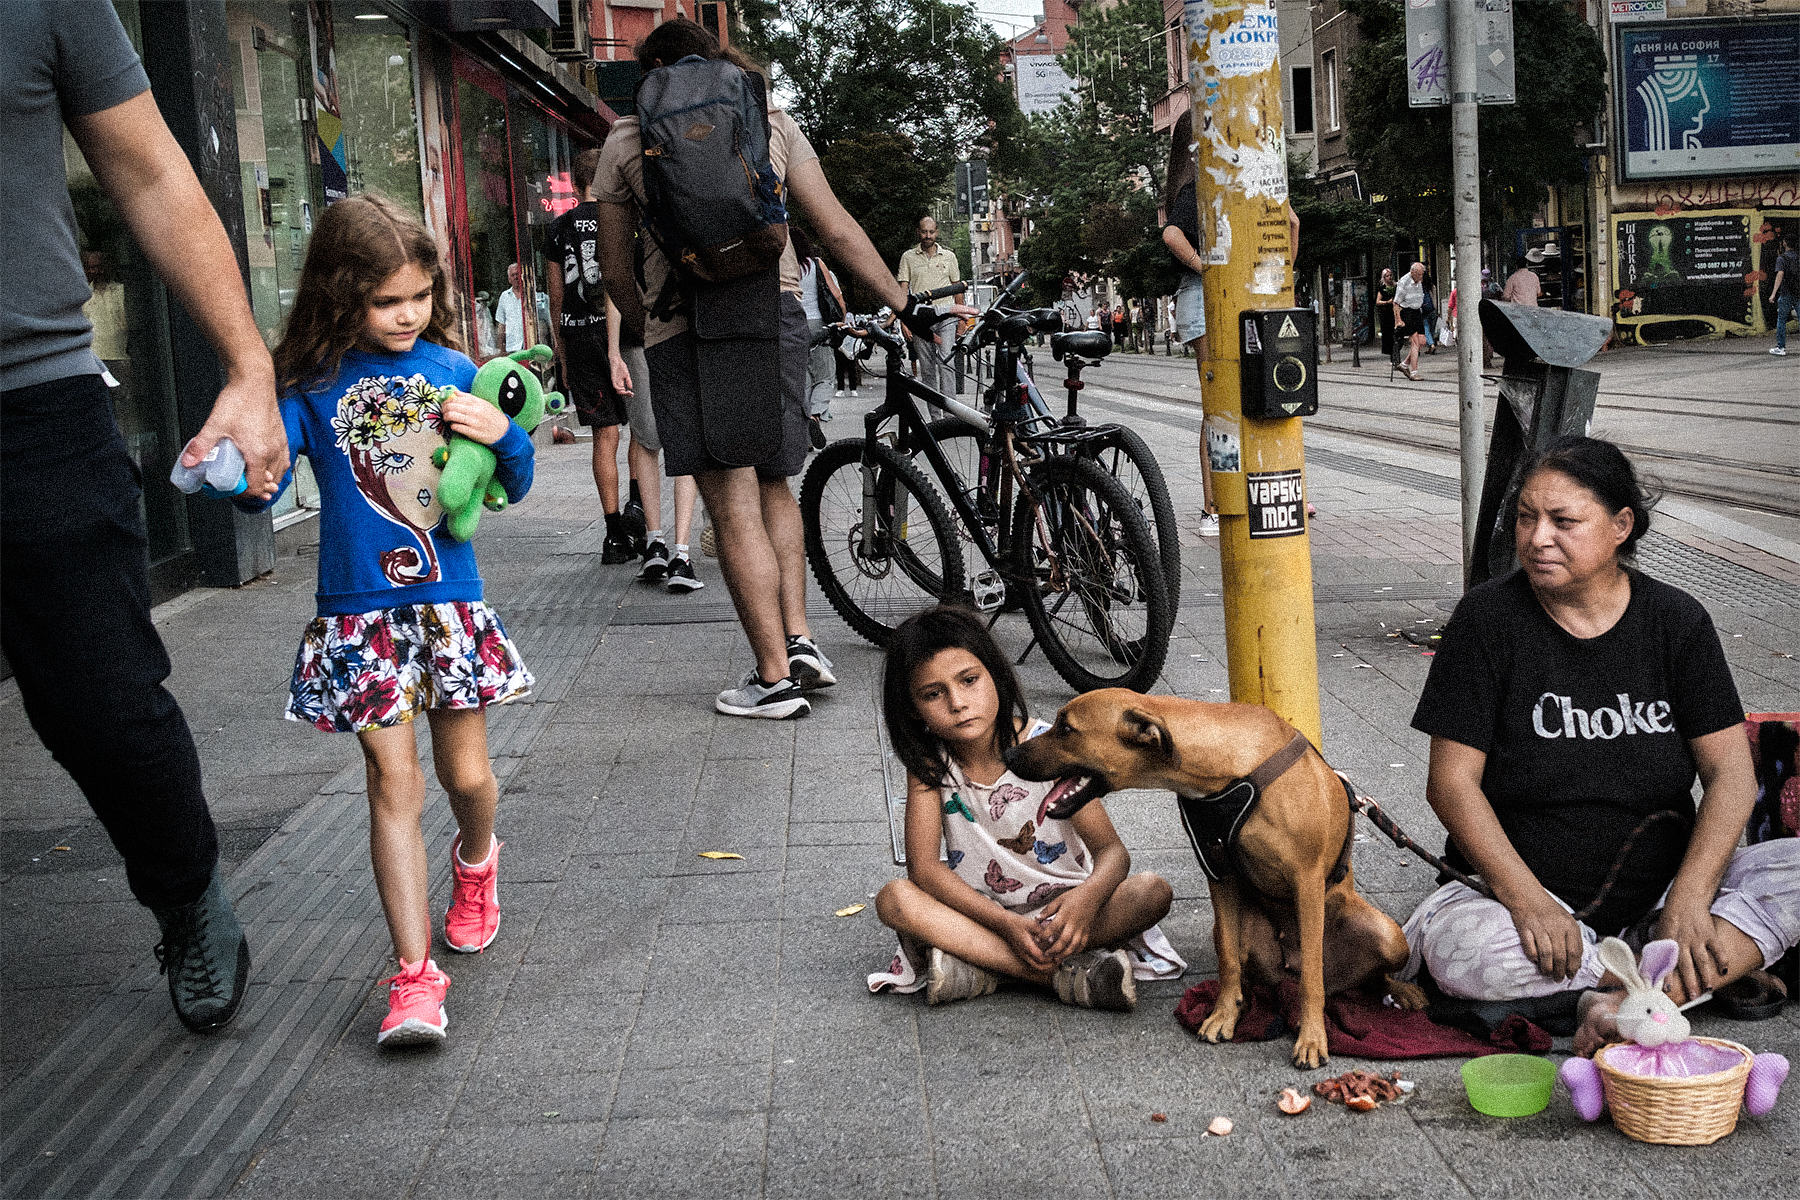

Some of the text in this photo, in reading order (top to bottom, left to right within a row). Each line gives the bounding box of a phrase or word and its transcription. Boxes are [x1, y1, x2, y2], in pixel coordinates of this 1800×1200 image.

[1611, 1, 1664, 12] METROPOLIS
[1633, 43, 1661, 54] ДЕНЯ
[1664, 42, 1679, 51] НА
[1681, 40, 1720, 51] СОФИЯ
[1707, 54, 1719, 62] 17
[1625, 223, 1637, 285] ШАПКАР
